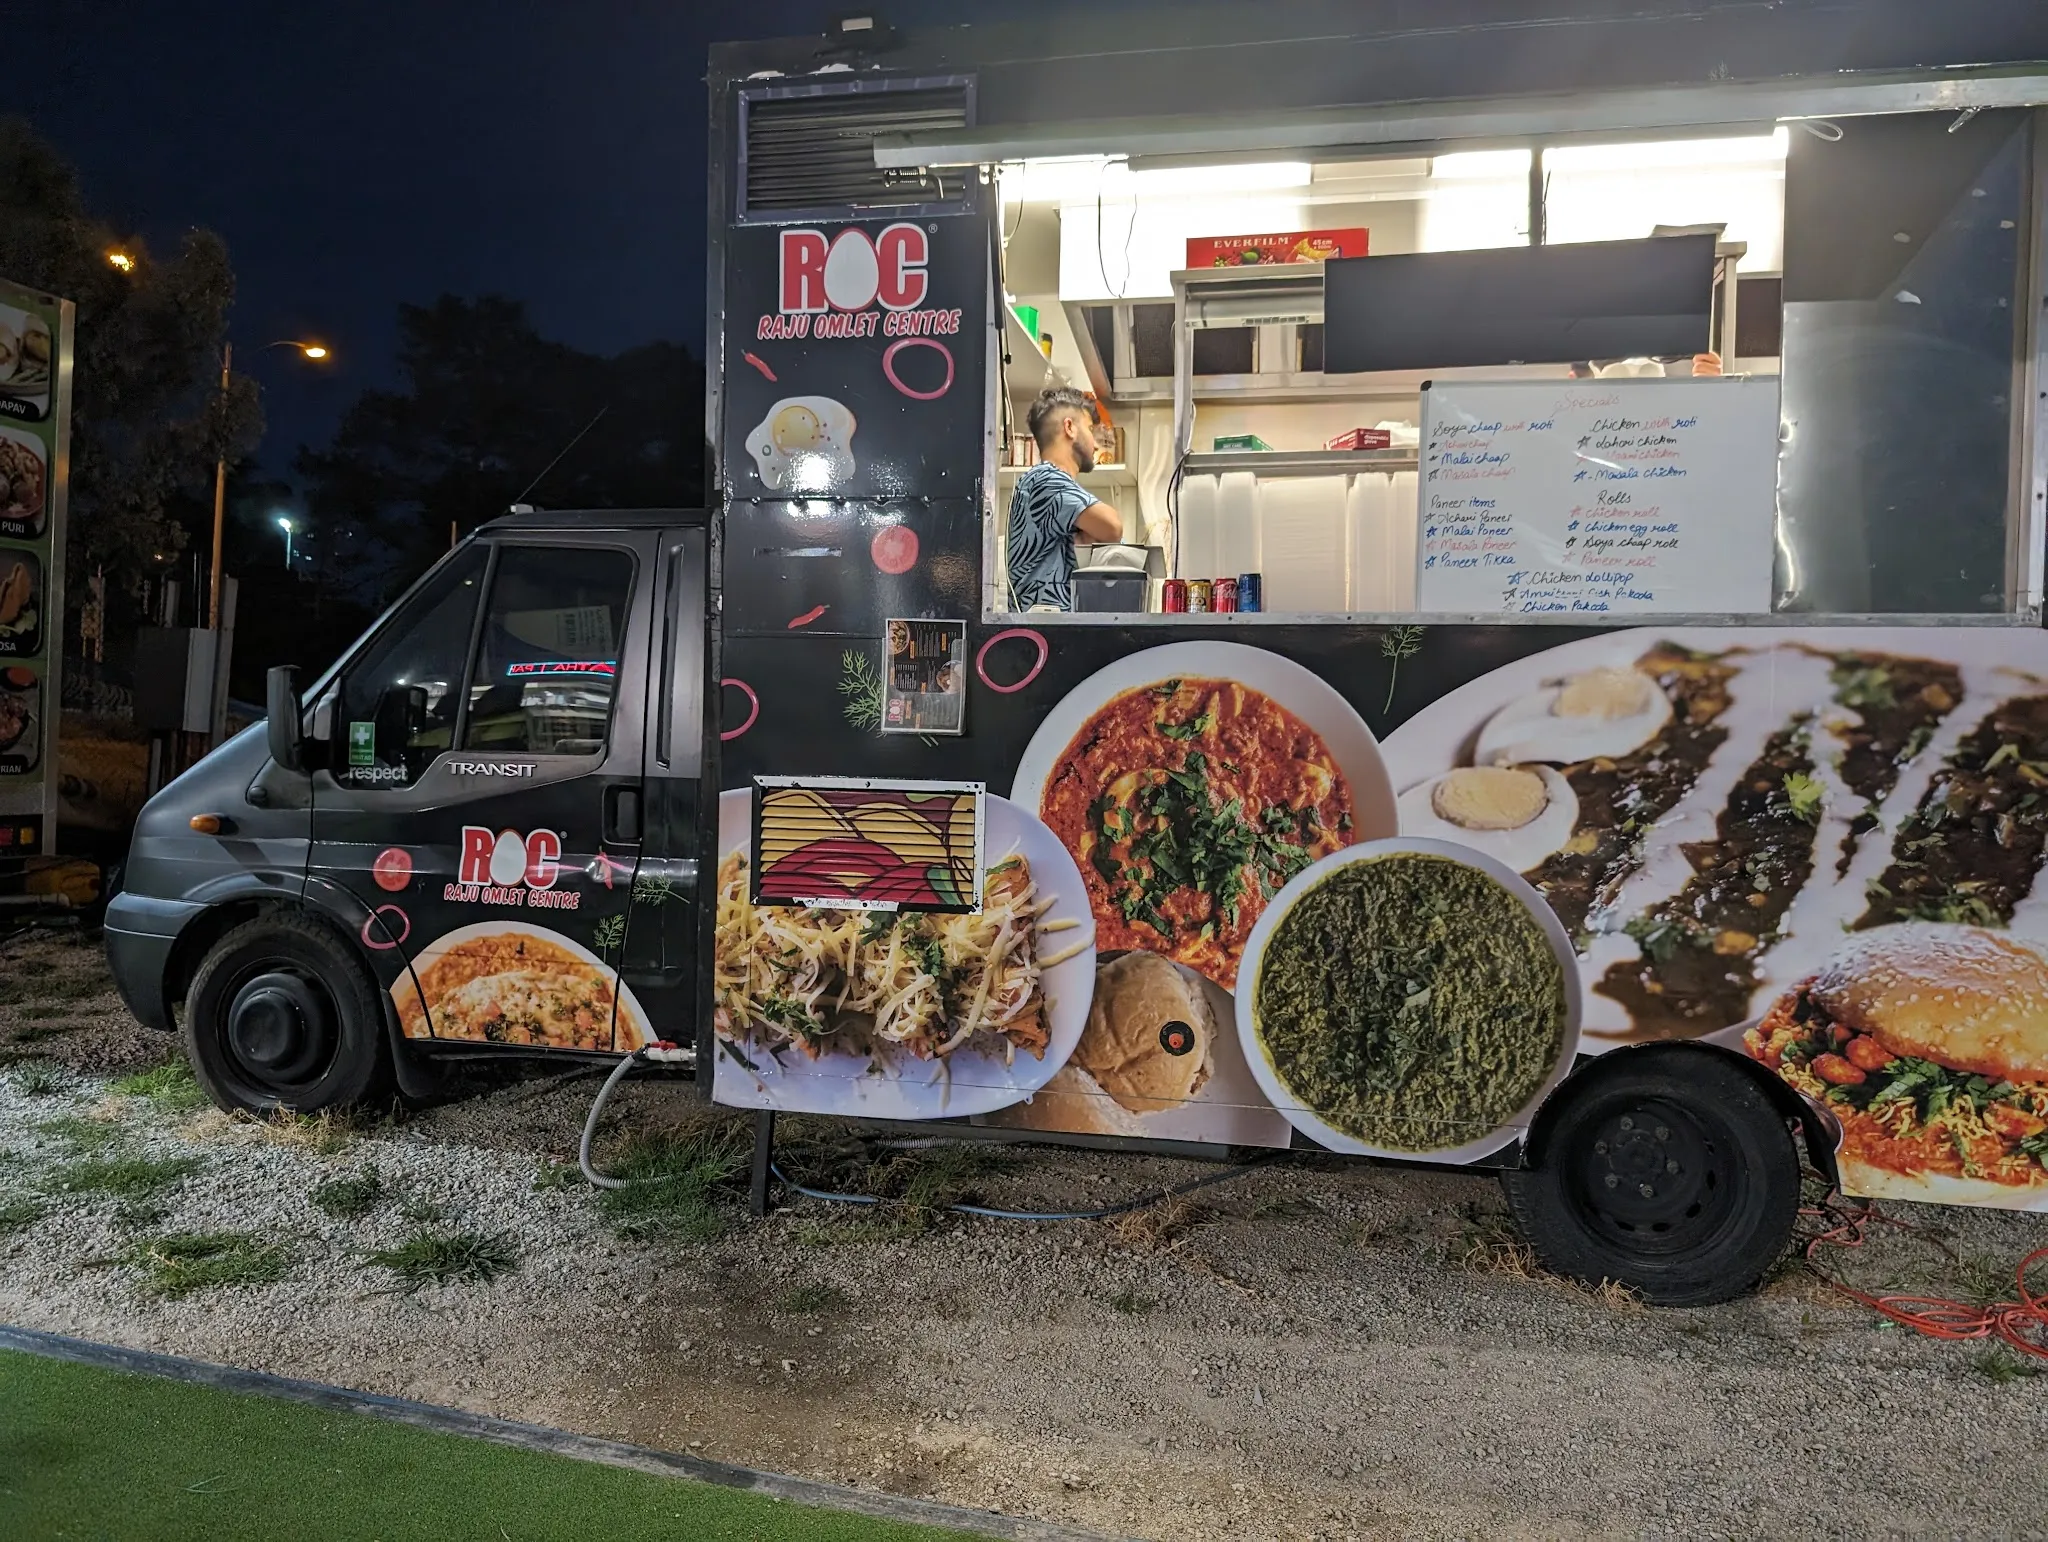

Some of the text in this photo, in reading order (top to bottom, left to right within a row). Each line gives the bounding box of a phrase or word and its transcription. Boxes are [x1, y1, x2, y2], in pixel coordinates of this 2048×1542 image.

[1213, 237, 1290, 248] EVERFILM
[757, 308, 962, 340] RAJU OMLET CENTRE
[0, 400, 26, 414] APAV
[1432, 421, 1467, 438] Soya
[1528, 419, 1554, 431] roti
[1590, 418, 1640, 432] Chicken
[1671, 416, 1698, 429] roti
[1431, 494, 1496, 509] Paneer items
[1597, 489, 1632, 505] Rolls
[1480, 510, 1513, 523] Paneer
[2, 521, 25, 534] PURI
[1441, 524, 1513, 537] Malai Paneer
[1629, 524, 1648, 538] egg
[1650, 523, 1680, 533] roll
[1481, 537, 1517, 550] Paneer
[1651, 538, 1679, 549] roll
[1440, 552, 1478, 568] Paneer
[1580, 552, 1623, 566] Paneer
[1526, 571, 1582, 585] Chicken
[1520, 600, 1610, 613] Chicken Pakoda
[349, 764, 408, 783] respect
[447, 761, 537, 778] TRANSIT
[443, 883, 581, 910] RAJU OMLET CENTRE
